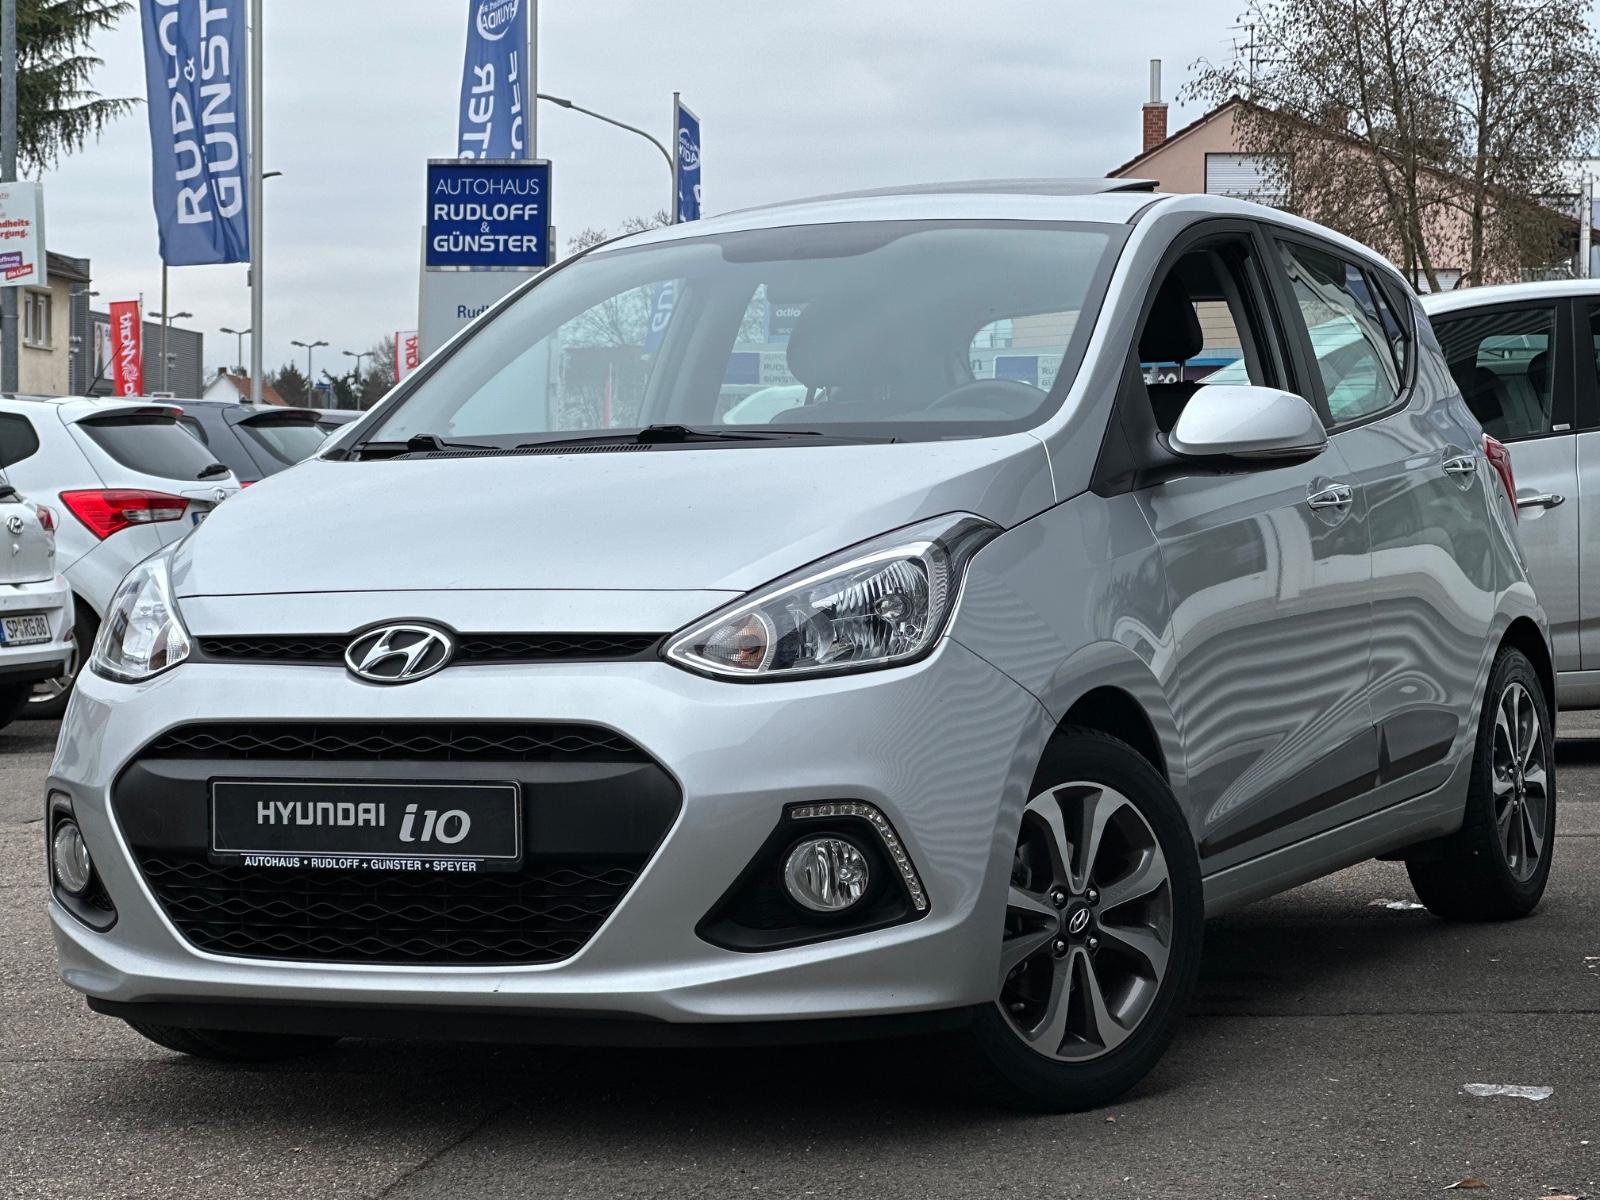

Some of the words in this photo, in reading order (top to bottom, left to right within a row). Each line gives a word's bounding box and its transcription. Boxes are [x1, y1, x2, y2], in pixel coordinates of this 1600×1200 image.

[435, 178, 539, 195] AUTOHAUS
[434, 203, 538, 220] RUDLOFF
[480, 221, 490, 233] &
[433, 231, 537, 252] GÜNSTER
[6, 620, 18, 639] SP
[257, 801, 385, 827] HYUNDAI
[399, 803, 471, 844] i10
[244, 856, 300, 867] AUTOHAUS
[311, 858, 360, 869] RUDLOFF
[370, 859, 421, 871] GÜNSTER
[433, 861, 476, 872] SPEYER
